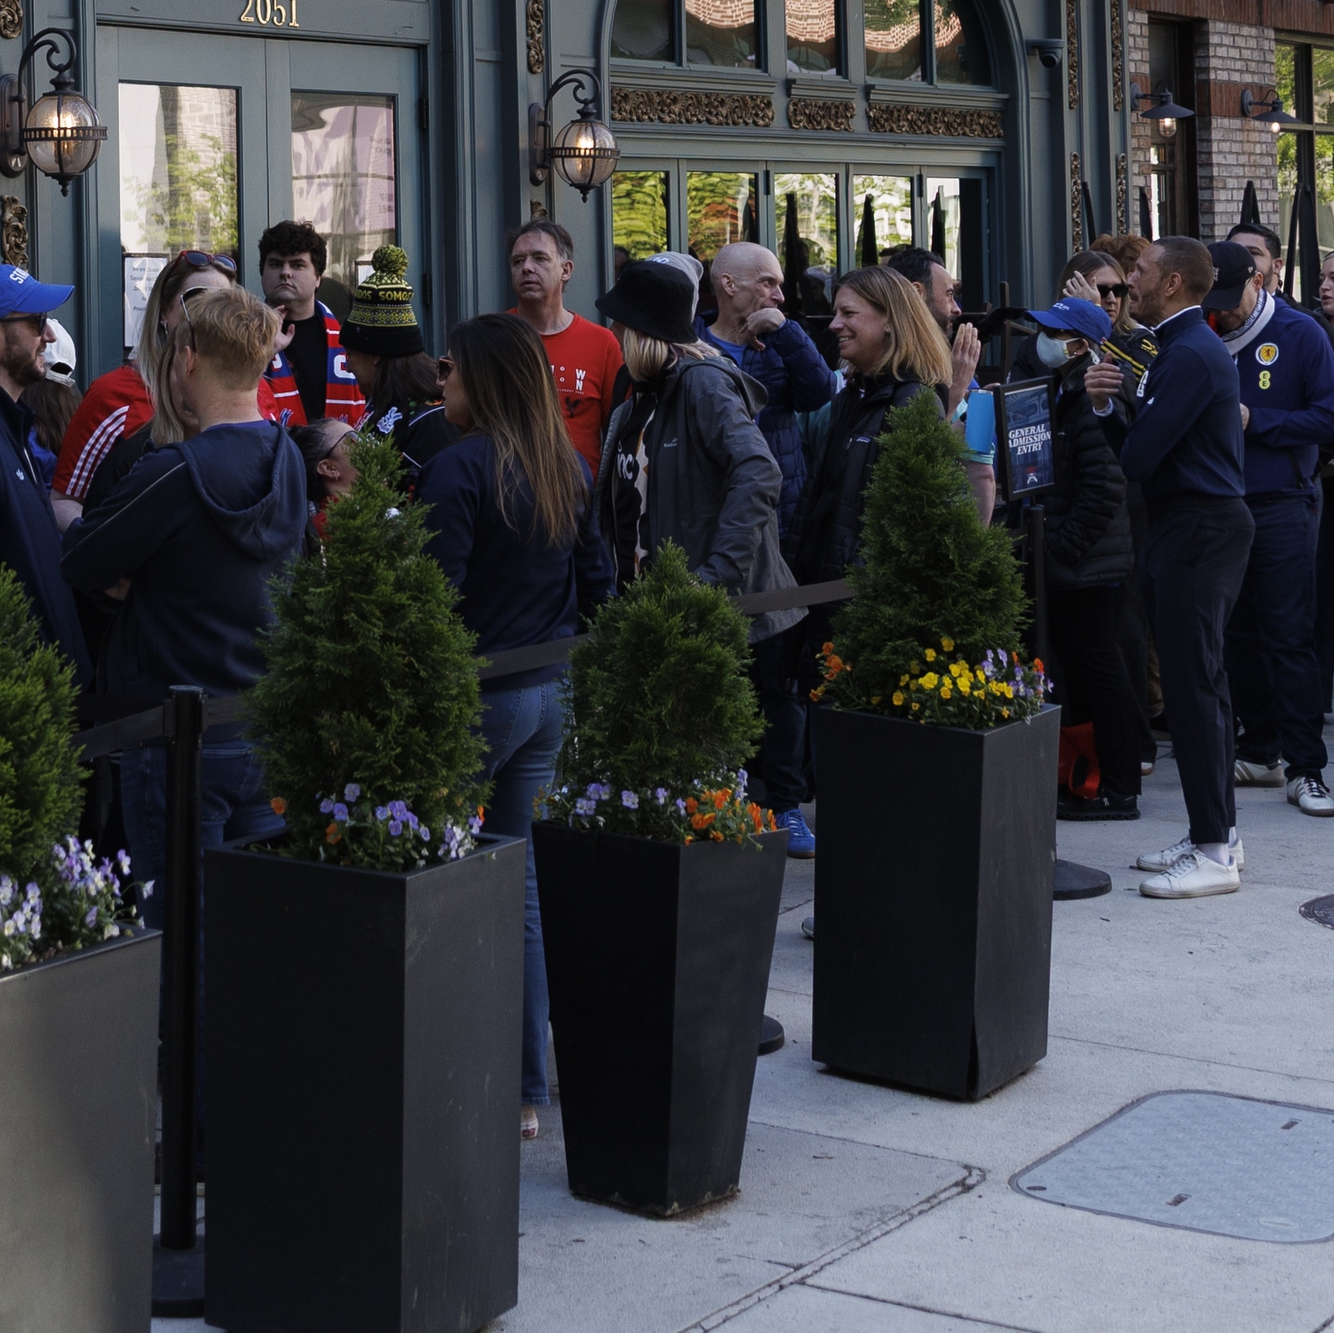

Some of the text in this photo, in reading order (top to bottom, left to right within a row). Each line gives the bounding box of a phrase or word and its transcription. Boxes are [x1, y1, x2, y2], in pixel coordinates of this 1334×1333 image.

[378, 290, 415, 301] SOMOS
[1008, 424, 1046, 439] GENERAL
[1017, 442, 1043, 456] ENTRY
